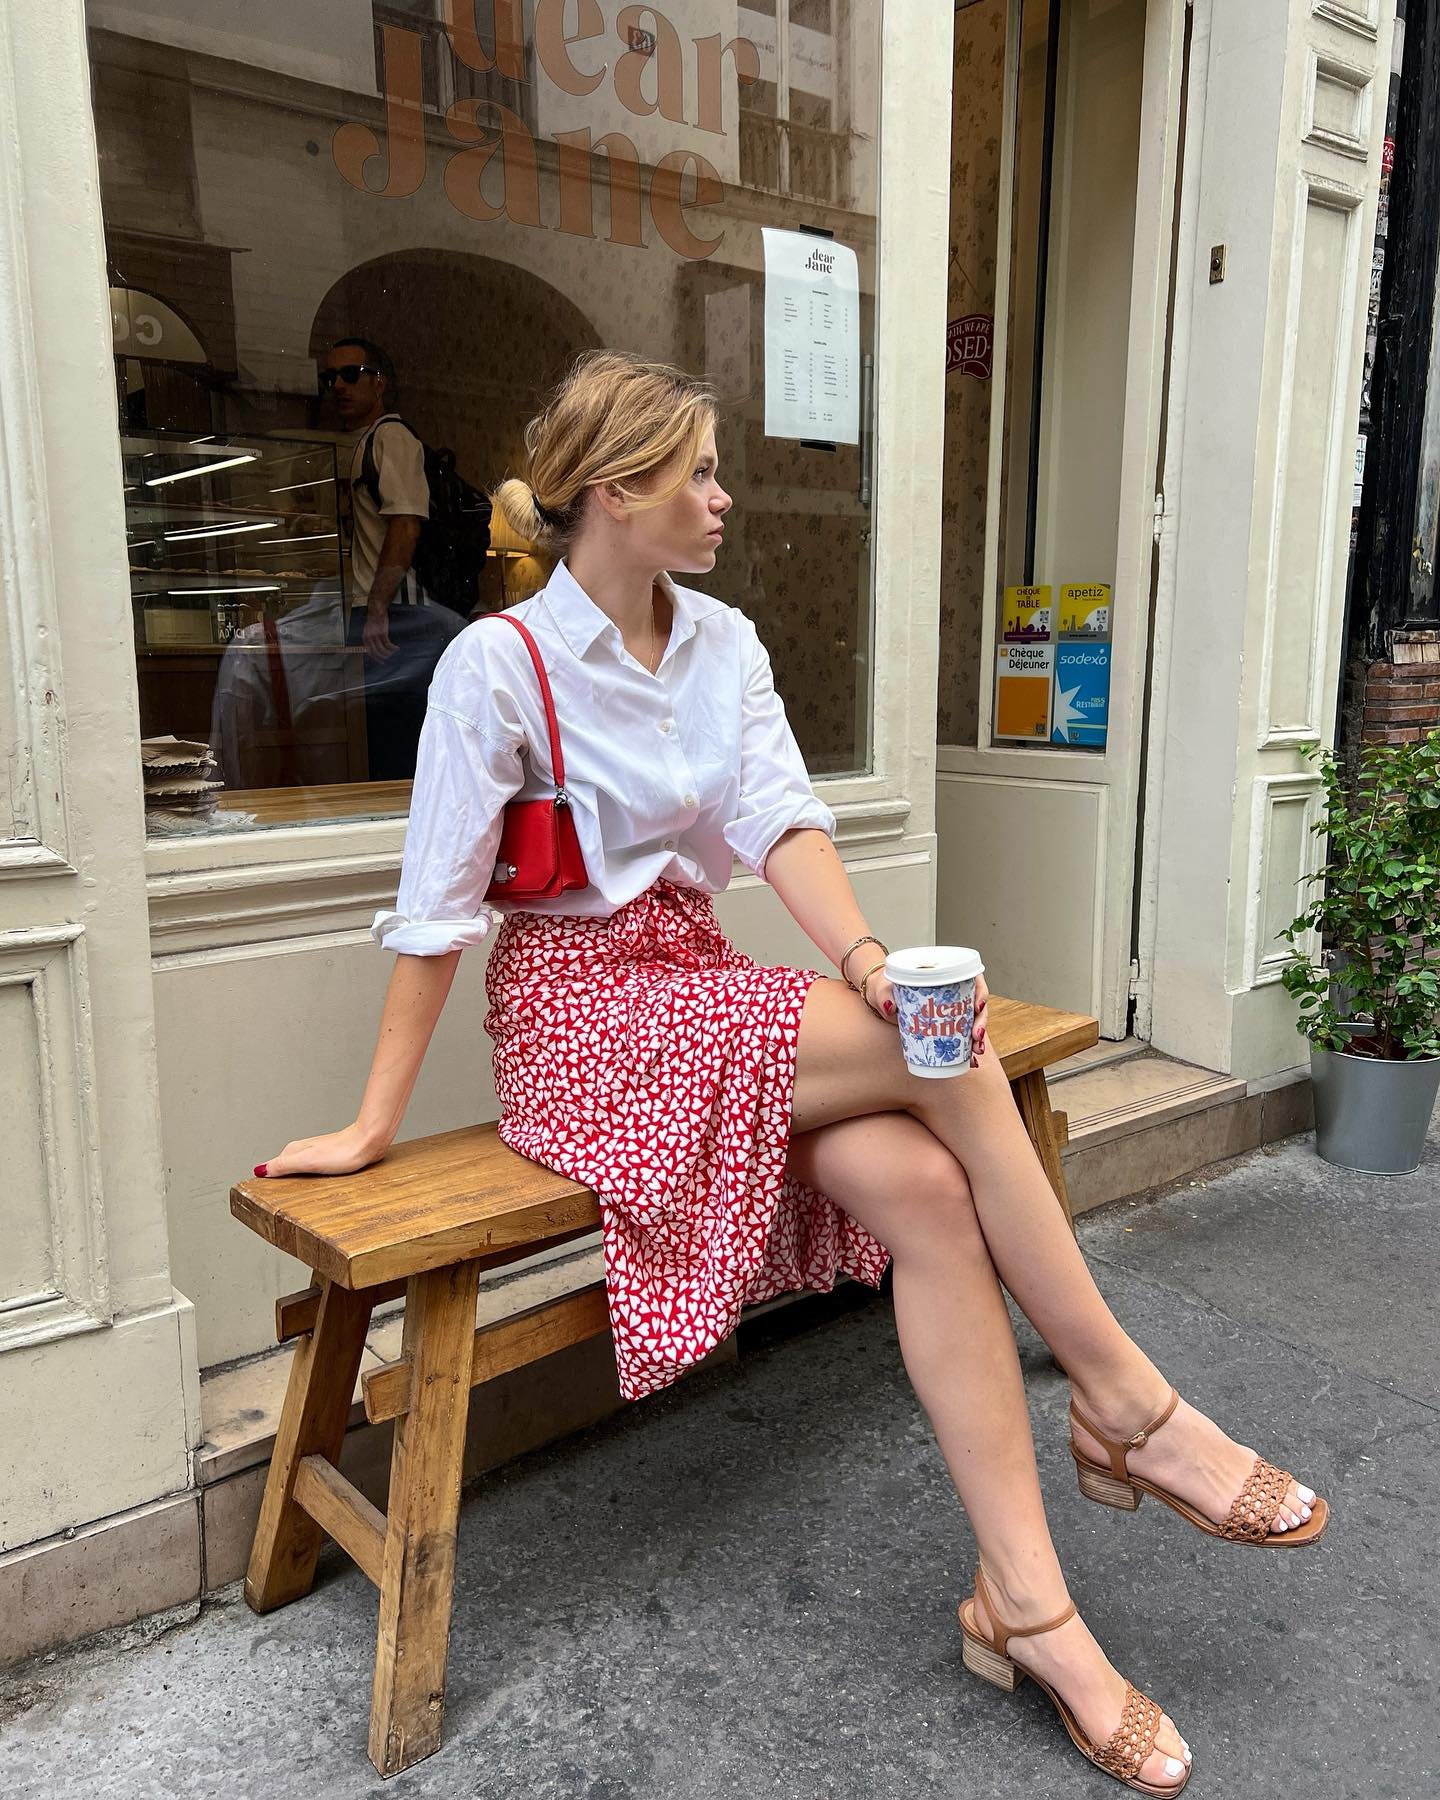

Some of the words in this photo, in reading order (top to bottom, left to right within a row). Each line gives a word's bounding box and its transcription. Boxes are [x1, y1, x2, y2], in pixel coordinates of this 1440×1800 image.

[332, 22, 726, 260] Jane
[812, 248, 836, 264] dear
[805, 256, 833, 274] Jane
[1067, 586, 1104, 600] apetiz
[1016, 599, 1041, 609] TABLE
[1009, 647, 1045, 660] Chèque
[1059, 653, 1108, 666] sodexo
[1008, 658, 1050, 671] Déjeuner
[920, 997, 972, 1018] dear
[908, 1013, 969, 1038] Jane
